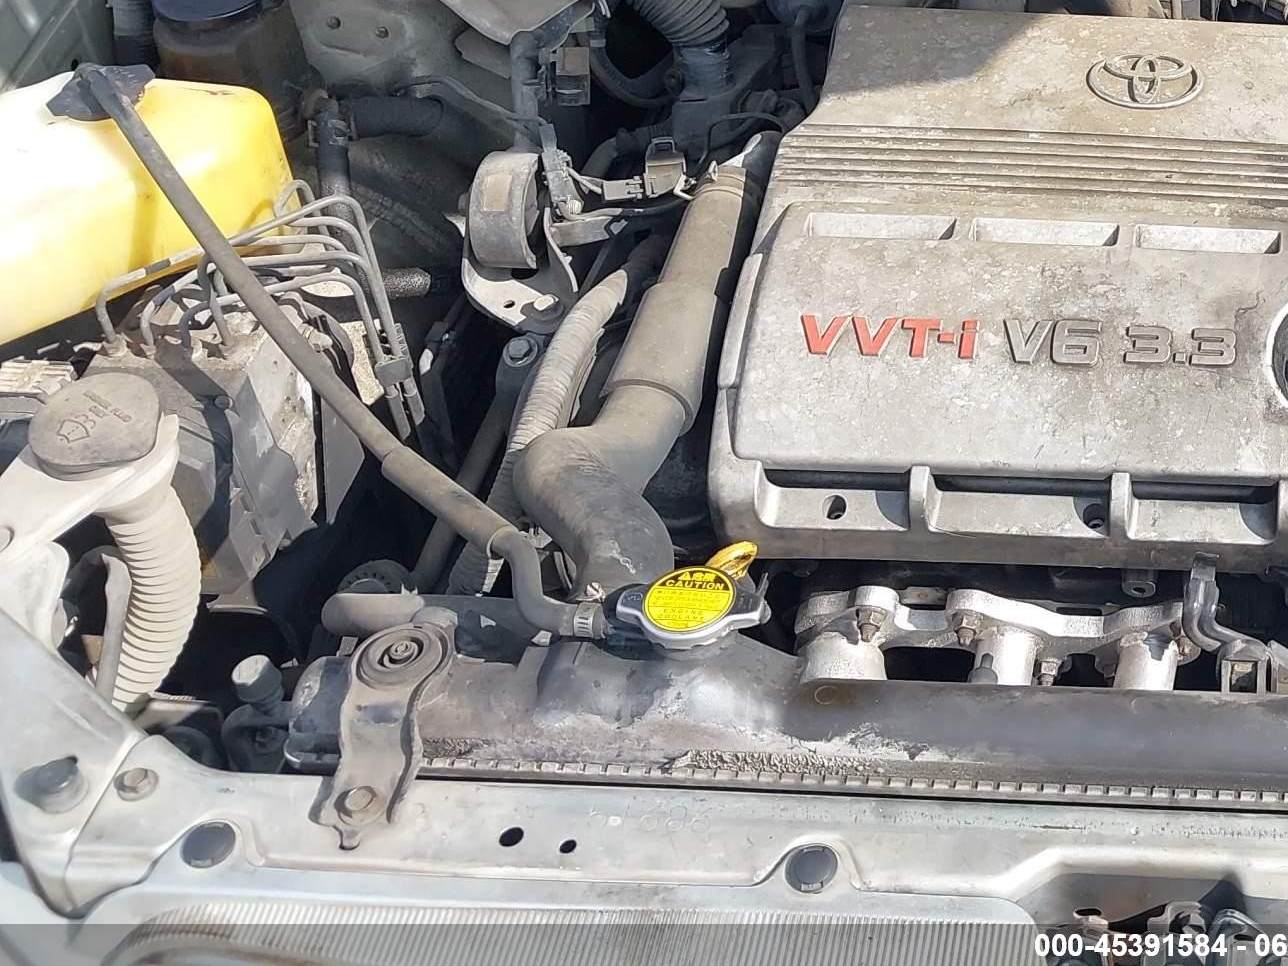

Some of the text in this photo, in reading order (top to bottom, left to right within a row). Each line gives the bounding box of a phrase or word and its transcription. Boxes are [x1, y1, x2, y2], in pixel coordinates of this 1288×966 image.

[801, 315, 1237, 367] VVT-i V6 3.3
[665, 579, 725, 590] CAUTION
[663, 608, 704, 616] ENGINE
